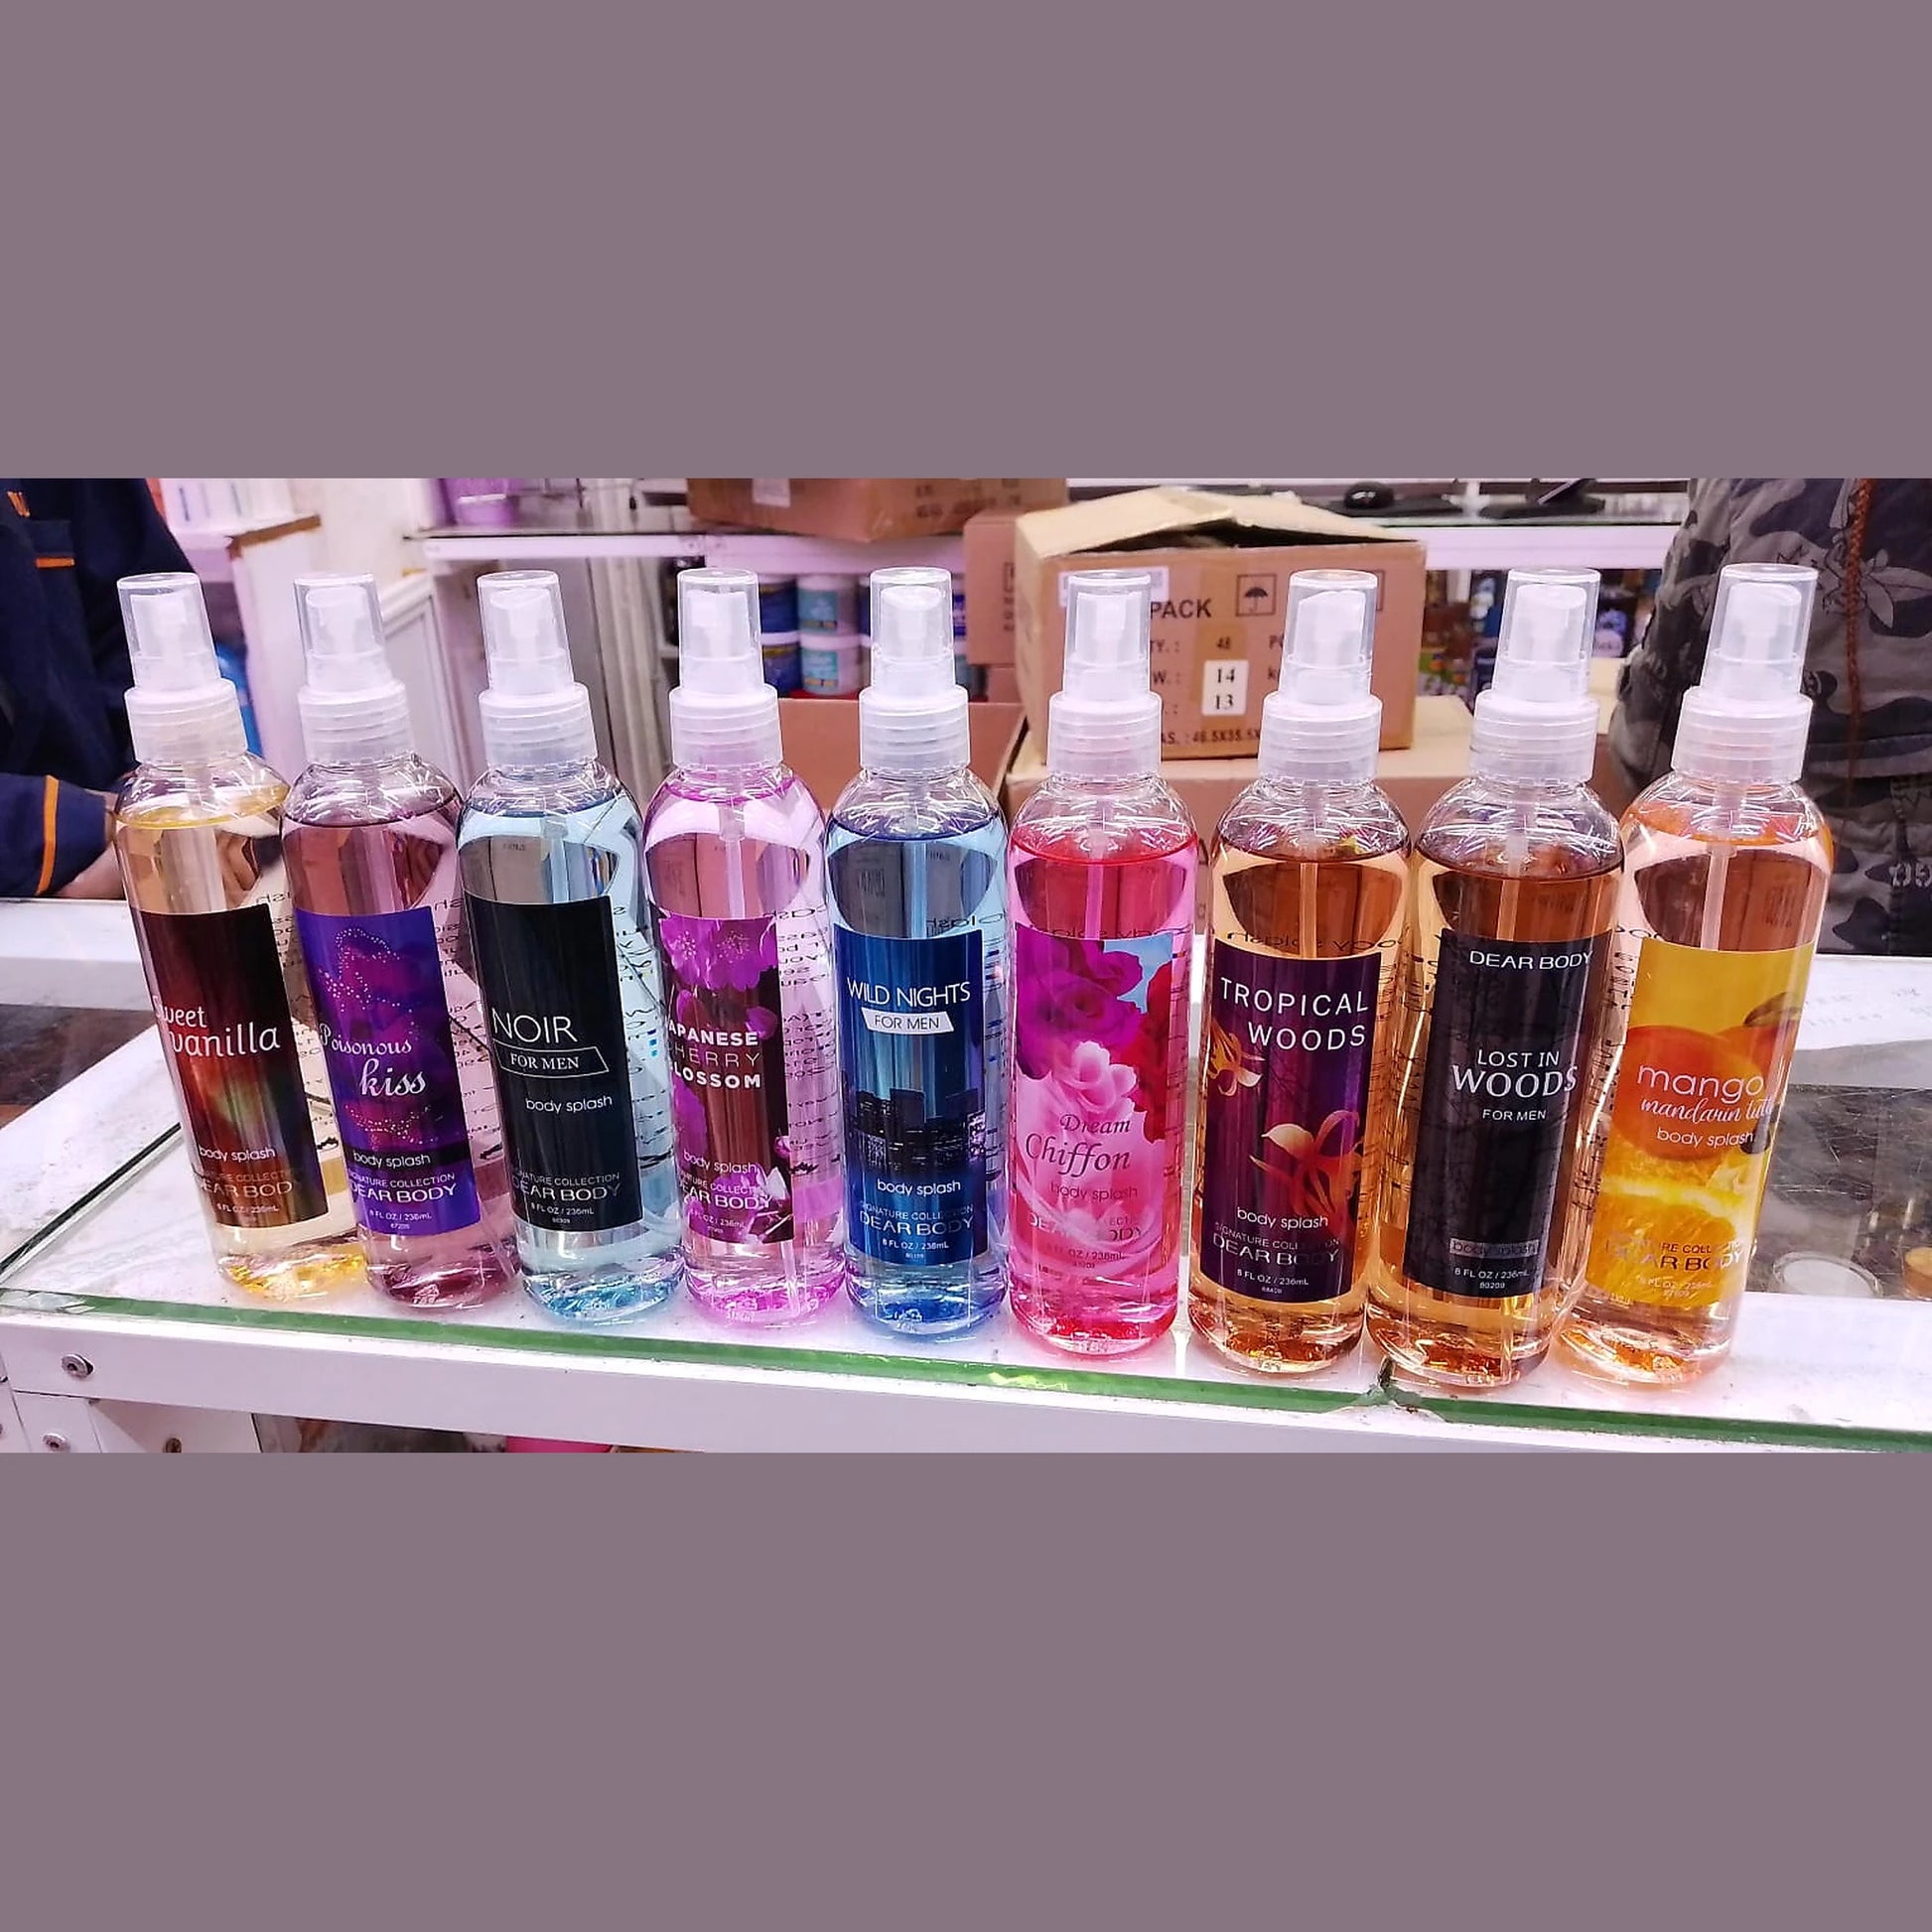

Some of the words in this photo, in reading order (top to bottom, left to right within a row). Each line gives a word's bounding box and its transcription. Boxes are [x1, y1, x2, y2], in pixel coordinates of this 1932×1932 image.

[1150, 598, 1211, 620] PACK
[1216, 666, 1235, 684] 14
[1215, 694, 1234, 710] 13
[1469, 950, 1533, 970] DEAR
[1539, 950, 1593, 970] BODY
[847, 977, 891, 1005] WILD
[897, 981, 971, 1008] NIGHTS
[1220, 977, 1368, 1016] TROPICAL
[491, 1008, 578, 1043] NOIR
[668, 1019, 759, 1046] APANESE
[875, 1015, 901, 1030] FOR
[906, 1017, 939, 1030] MEN
[170, 1022, 281, 1057] vanilla
[319, 1023, 412, 1055] Poisonous
[1248, 1022, 1365, 1051] WOODS
[510, 1053, 538, 1070] FOR
[541, 1056, 580, 1070] MEN
[1477, 1049, 1533, 1067] LOST
[1538, 1050, 1560, 1067] IN
[358, 1057, 427, 1096] kiss
[670, 1061, 760, 1088] LOSSOM
[1451, 1065, 1578, 1098] WOODS
[1638, 1064, 1764, 1104] mango
[525, 1098, 562, 1114] body
[566, 1095, 613, 1113] splash
[1641, 1098, 1741, 1124] mandarin
[1060, 1114, 1131, 1134] Dream
[1482, 1109, 1513, 1121] FOR
[1516, 1110, 1547, 1121] MEN
[1656, 1128, 1703, 1148] body
[1708, 1132, 1755, 1149] splash
[199, 1144, 228, 1162] body
[231, 1147, 276, 1163] splash
[353, 1152, 382, 1169] body
[386, 1154, 431, 1169] splash
[683, 1150, 710, 1170] body
[714, 1162, 758, 1174] splash
[1026, 1133, 1131, 1177] Chiffon
[390, 1173, 456, 1188] COLLECTION
[554, 1172, 620, 1187] COLLECTION
[877, 1178, 912, 1196] body
[916, 1180, 961, 1197] splash
[350, 1179, 393, 1202] DEAR
[397, 1183, 457, 1203] BODY
[561, 1184, 621, 1201] BODY
[1050, 1182, 1088, 1201] body
[1092, 1186, 1138, 1202] splash
[536, 1204, 547, 1213] FL
[547, 1206, 560, 1215] OZ
[566, 1207, 595, 1216] 236mL
[715, 1194, 772, 1209] BODY
[375, 1211, 384, 1220] FL
[860, 1211, 911, 1236] DEAR
[1237, 1206, 1277, 1228] body
[1281, 1214, 1328, 1231] splash
[889, 1240, 899, 1249] FL
[921, 1240, 949, 1250] 236mL
[1213, 1232, 1271, 1263] DEAR
[1245, 1272, 1256, 1281] FL
[1257, 1275, 1272, 1285] OZ
[1279, 1277, 1310, 1286] 236mL
[1463, 1268, 1475, 1278] FL
